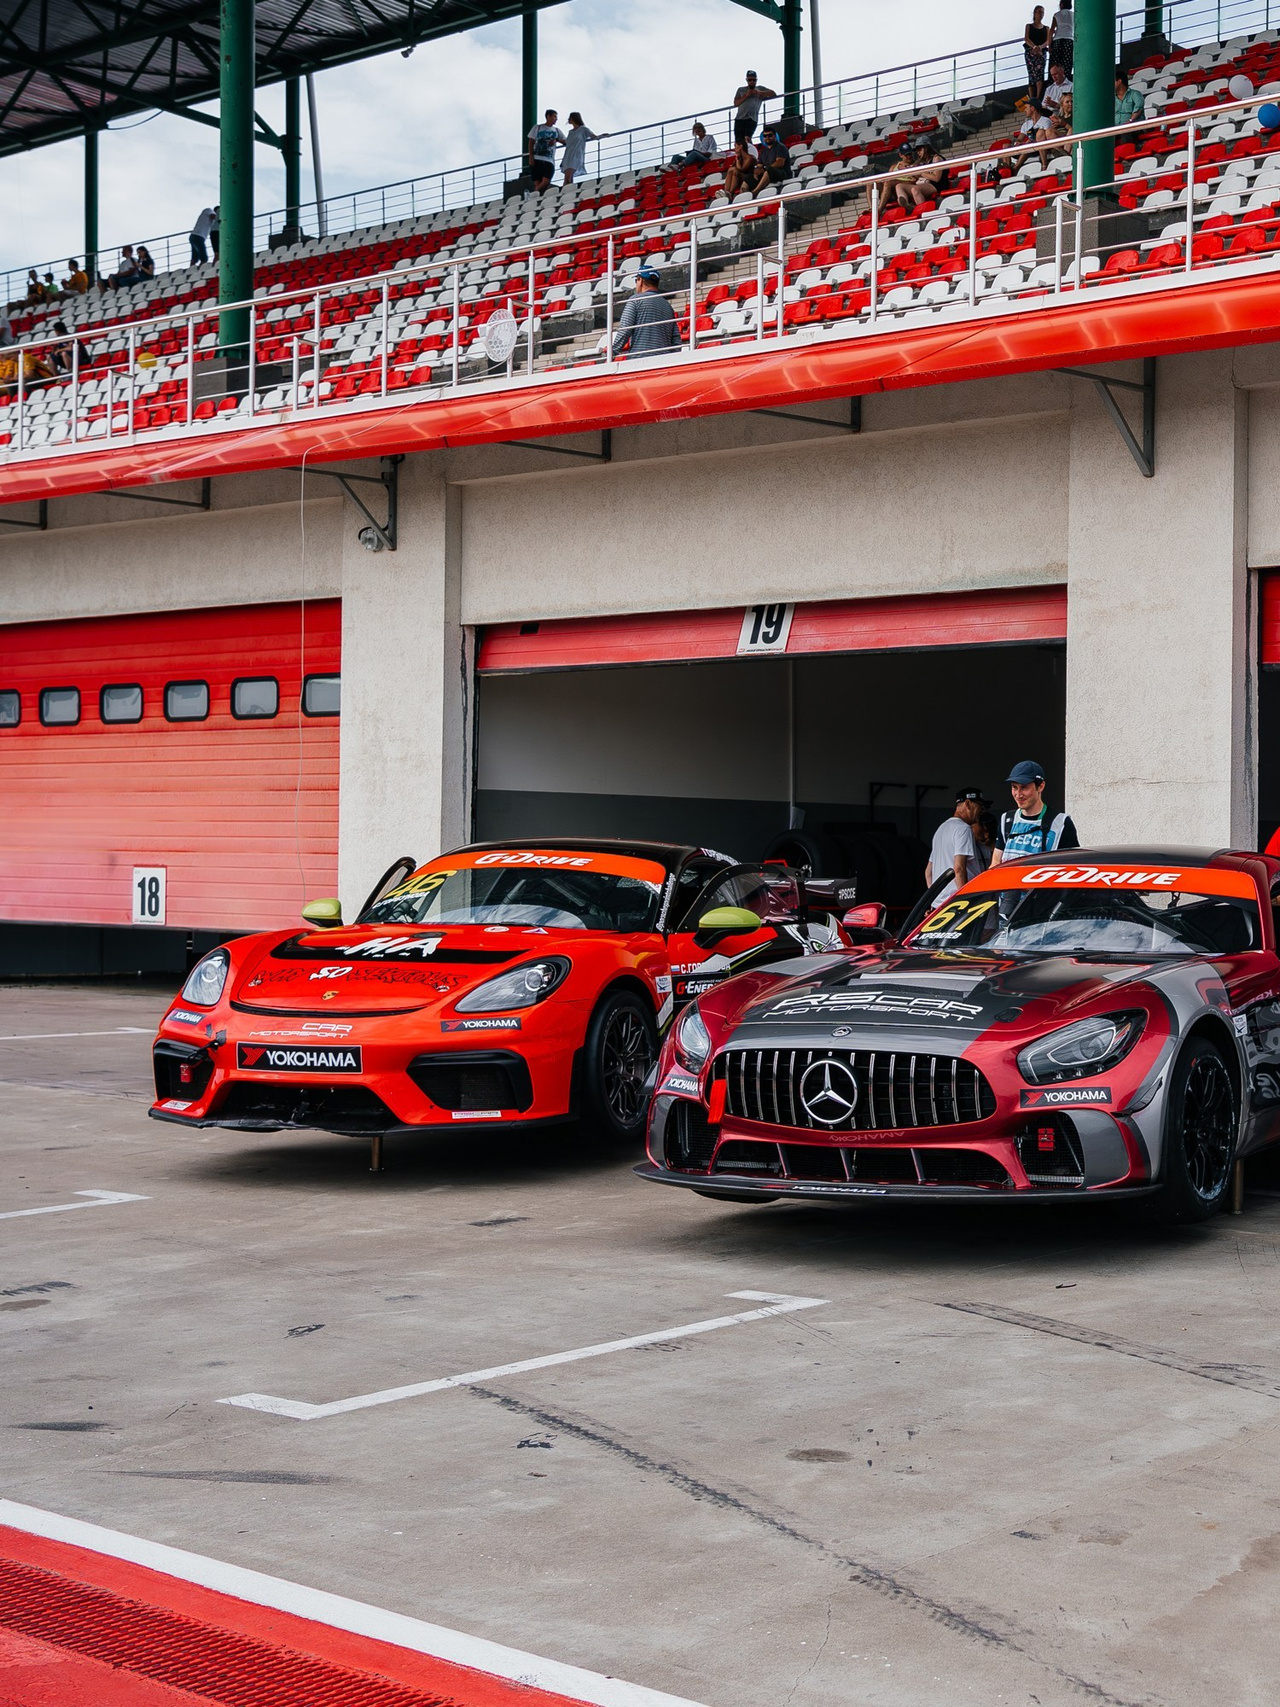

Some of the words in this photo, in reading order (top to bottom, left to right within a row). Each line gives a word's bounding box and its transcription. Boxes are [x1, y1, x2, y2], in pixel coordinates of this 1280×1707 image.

[749, 603, 787, 645] 19
[383, 870, 457, 899] 46
[137, 876, 160, 917] 18
[921, 900, 997, 933] 61
[309, 966, 353, 980] SO
[762, 1003, 975, 1022] MOTORSPORT
[462, 1018, 518, 1029] YOKOHAMA
[249, 1030, 349, 1038] MOTORSPORT
[266, 1050, 357, 1067] YOKOHAMA
[1044, 1090, 1108, 1102] YOKOHAMA
